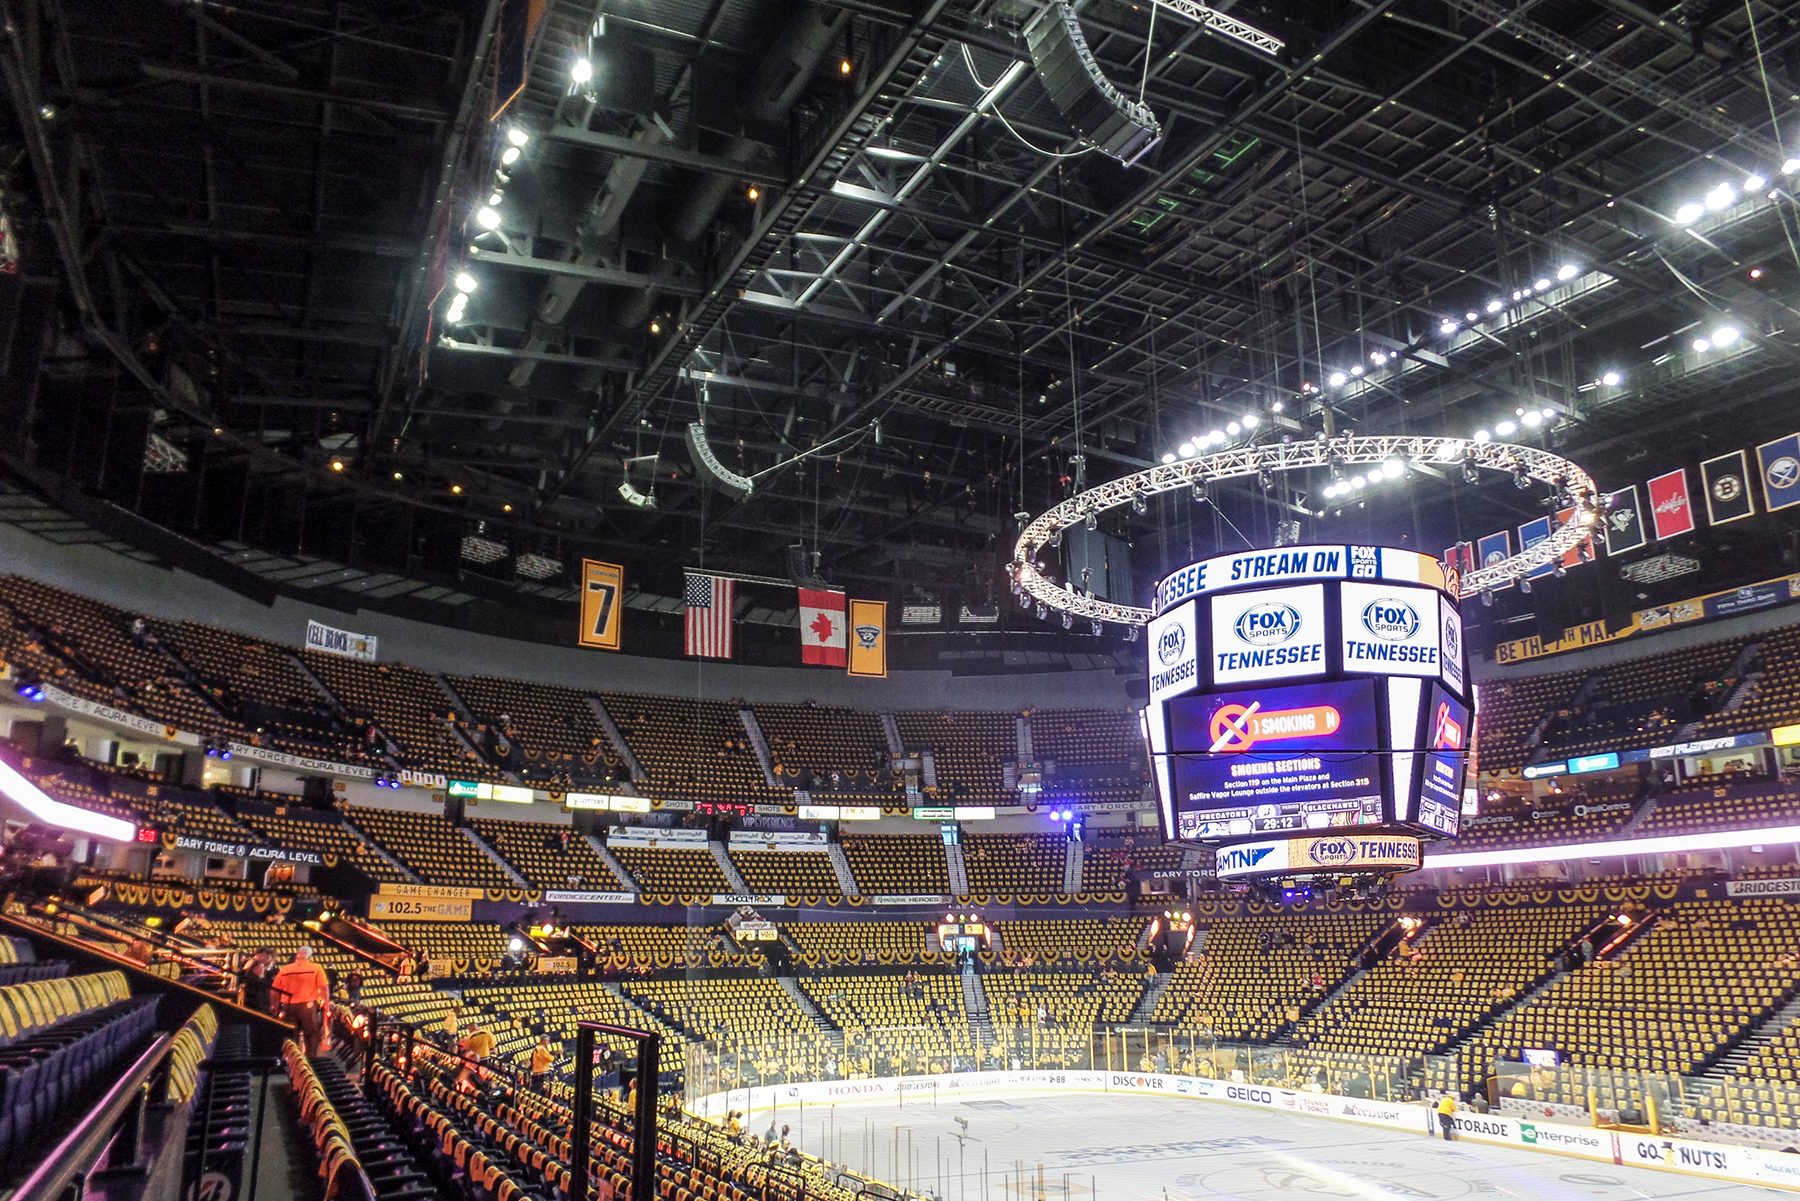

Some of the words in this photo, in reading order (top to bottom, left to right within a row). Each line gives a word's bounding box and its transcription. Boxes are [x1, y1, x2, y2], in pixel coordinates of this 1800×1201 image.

[1351, 546, 1377, 559] FOX
[1231, 552, 1308, 580] STREAM
[1313, 551, 1340, 573] ON
[1352, 564, 1377, 577] GO
[587, 579, 617, 638] 7
[1375, 606, 1407, 625] FOX
[1249, 610, 1286, 630] FOX
[1375, 623, 1409, 633] SPORTS
[1163, 629, 1180, 651] FOX
[1249, 627, 1288, 638] SPORTS
[1163, 646, 1181, 660] SPORTS
[1218, 644, 1323, 671] TENNESSEE
[1346, 640, 1437, 664] TENNESSEE
[1500, 643, 1517, 662] BE
[1151, 658, 1196, 693] TENNESSEE
[94, 706, 128, 722] ACURA
[131, 718, 162, 734] LEVEL
[1261, 713, 1317, 735] SMOKING
[252, 749, 287, 763] FORCE
[300, 758, 335, 771] ACURA
[338, 765, 373, 777] LEVEL
[1230, 762, 1275, 777] SMOKING
[1275, 758, 1321, 773] SECTIONS
[1189, 792, 1210, 800] Saffire
[1211, 790, 1230, 799] Vapor
[1231, 789, 1255, 798] Lounge
[1255, 786, 1279, 794] outside
[1280, 783, 1290, 791] the
[1291, 781, 1321, 791] elevators
[1330, 780, 1355, 788] Section
[1224, 781, 1248, 789] Section
[1270, 776, 1282, 784] the
[1282, 775, 1298, 783] Main
[1299, 774, 1317, 782] Plaza
[664, 801, 688, 809] SHOTS
[1100, 803, 1135, 811] FORCE
[1308, 801, 1358, 812] BLACKHAWKS
[1200, 811, 1247, 821] PREDATORS
[1263, 817, 1294, 829] 29:12
[176, 837, 202, 849] GARY
[204, 841, 236, 855] FORCE
[250, 848, 286, 860] ACURA
[288, 852, 320, 863] LEVEL
[1320, 841, 1347, 855] FOX
[1320, 853, 1348, 861] SPORTS
[396, 884, 422, 895] GAME
[427, 886, 471, 897] CHANGER
[388, 901, 422, 914] 102.5
[422, 905, 437, 913] THE
[437, 903, 471, 917] GAME
[828, 1083, 884, 1096] HONDA
[1112, 1075, 1163, 1089] DISCOVER
[1227, 1086, 1272, 1104] GEICO
[1377, 1110, 1400, 1121] LIGHT
[1449, 1118, 1509, 1137] ATORADE
[1522, 1127, 1600, 1147] enterprise
[1637, 1141, 1659, 1160] GO
[1679, 1146, 1728, 1170] NUTS!
